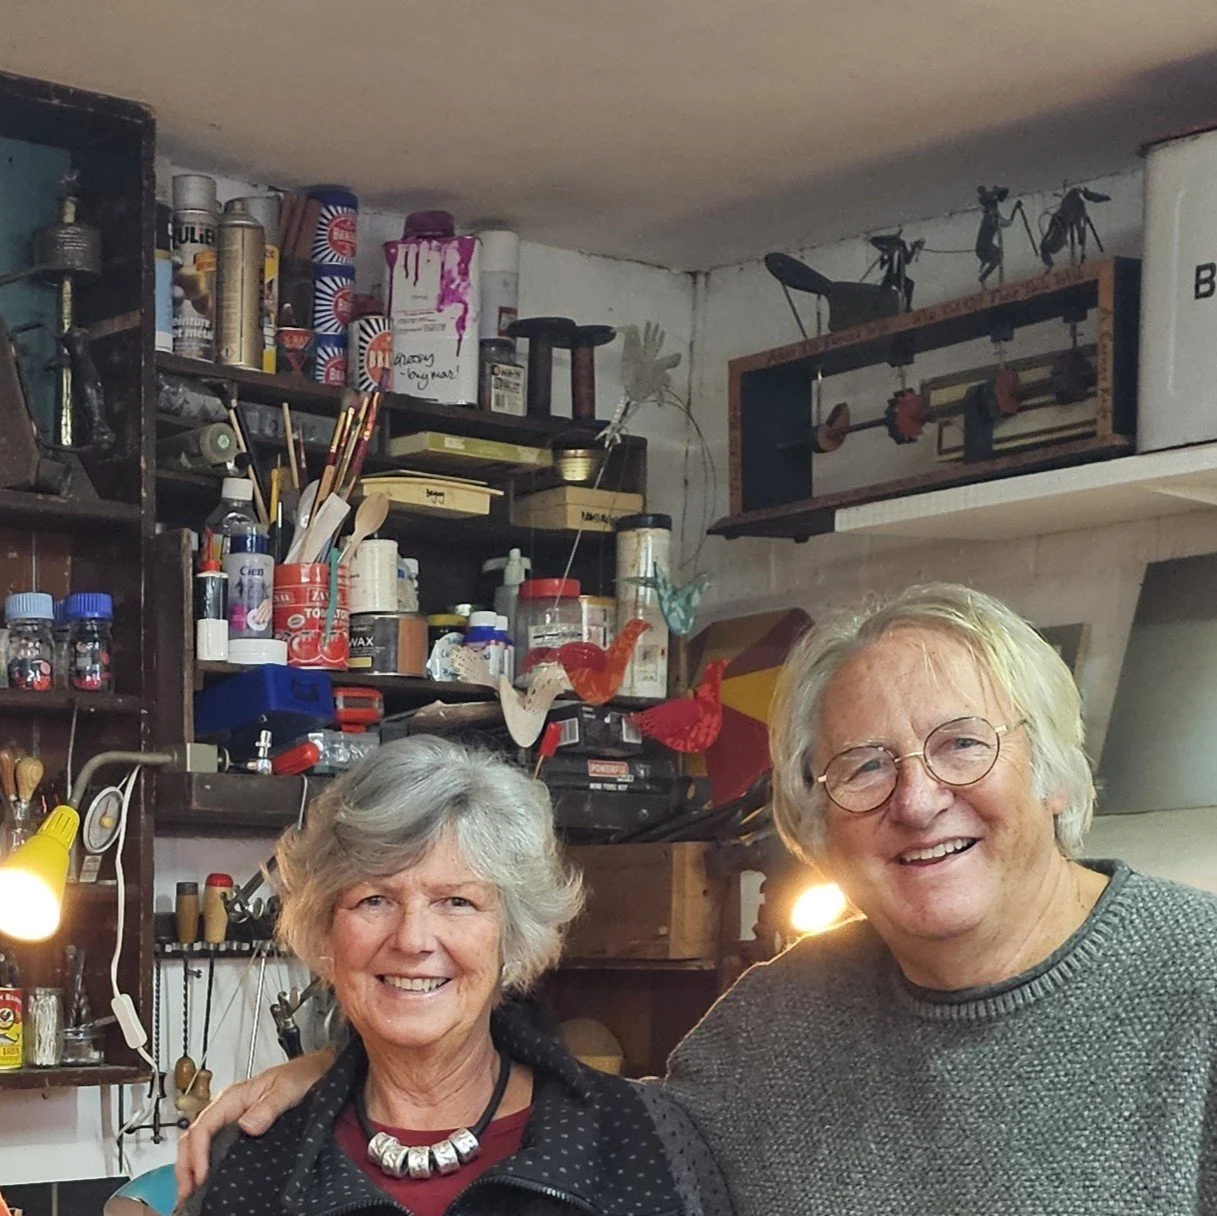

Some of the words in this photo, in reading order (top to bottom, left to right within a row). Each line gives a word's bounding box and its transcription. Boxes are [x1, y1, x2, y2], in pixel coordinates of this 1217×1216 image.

[1195, 262, 1217, 300] B
[172, 317, 211, 329] einture
[240, 565, 264, 577] Cien
[348, 636, 374, 647] WAX
